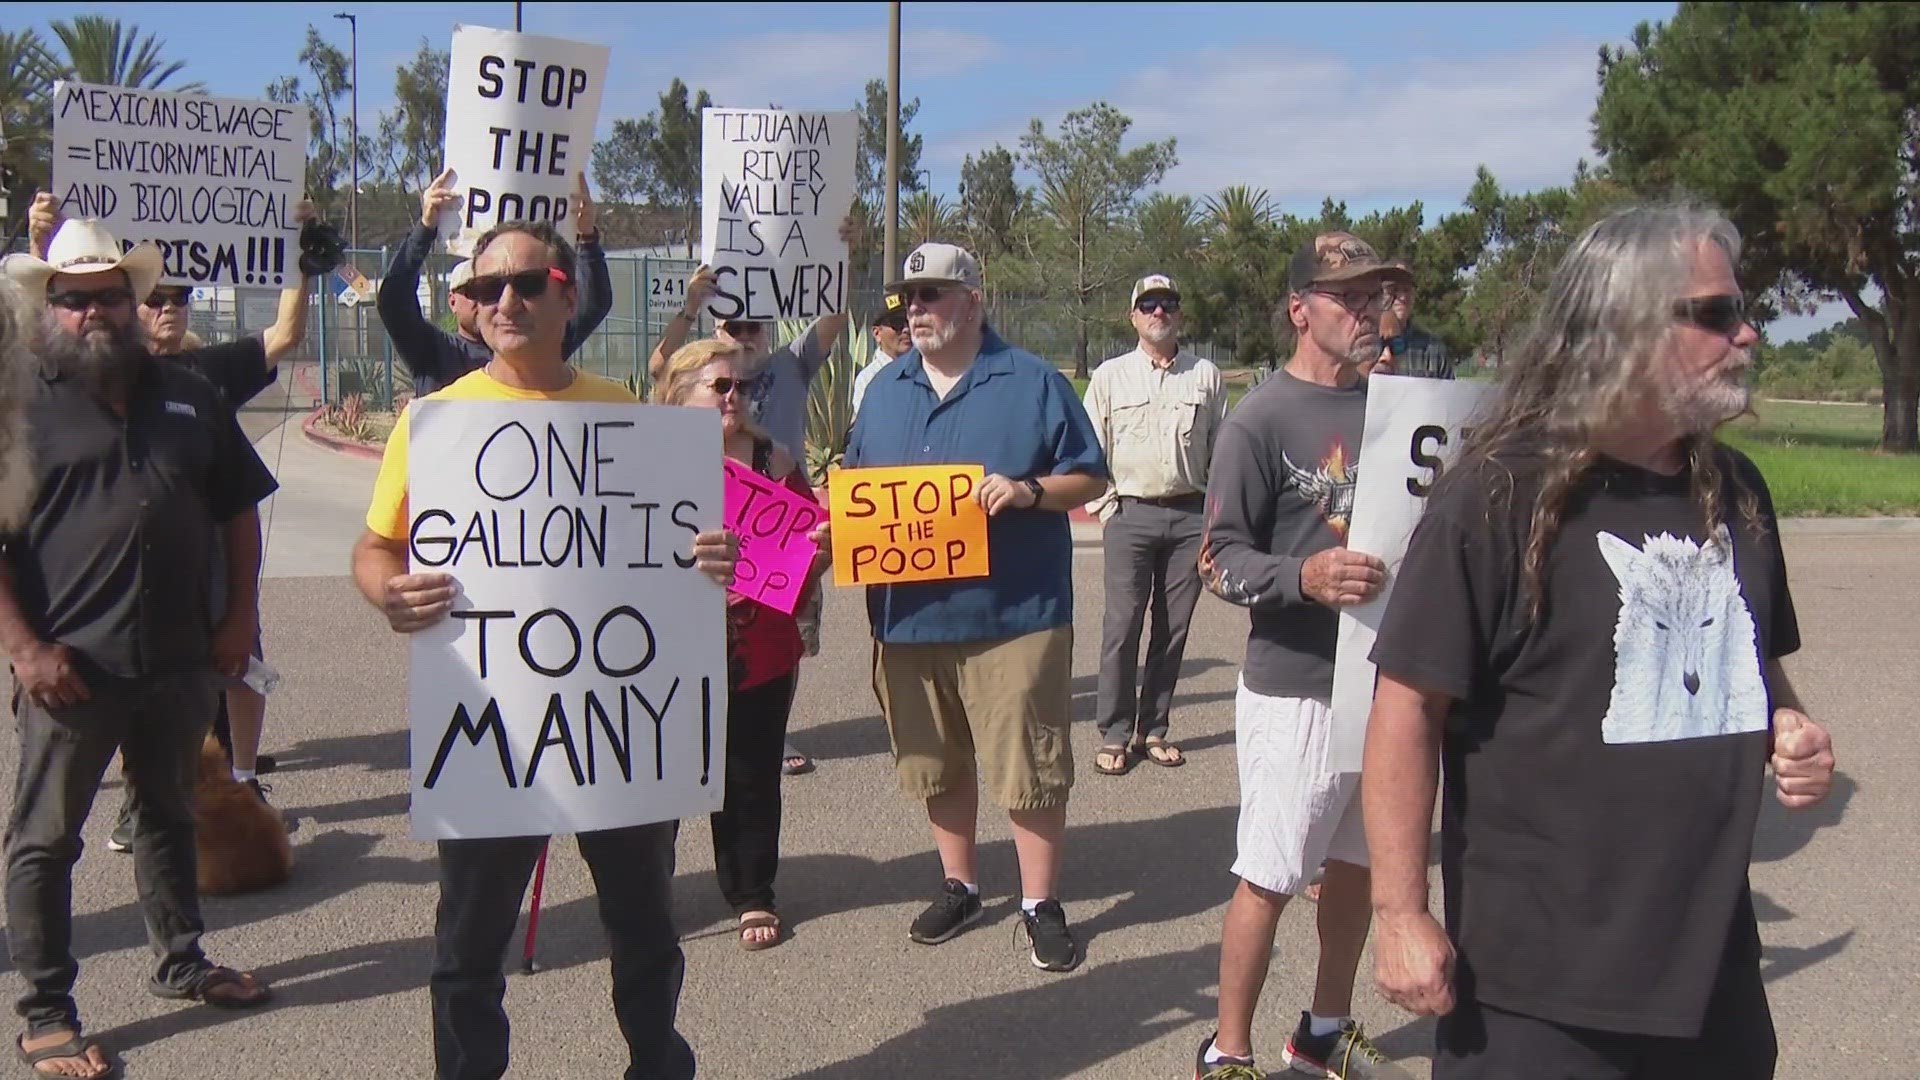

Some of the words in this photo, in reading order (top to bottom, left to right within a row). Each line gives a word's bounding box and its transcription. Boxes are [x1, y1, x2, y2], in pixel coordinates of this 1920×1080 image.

[478, 55, 587, 110] STOP
[60, 87, 178, 130] MEXICAN
[185, 100, 294, 142] SEWAGE
[713, 113, 831, 146] TIJUANA
[489, 126, 569, 177] THE
[743, 149, 824, 182] RIVER
[59, 182, 118, 218] AND
[130, 182, 299, 231] BIOLOGICAL
[466, 187, 568, 229] POOP
[721, 183, 826, 216] VALLEY
[715, 217, 765, 257] IS
[779, 219, 809, 258] A
[475, 420, 635, 502] ONE
[723, 465, 817, 553] TOP
[846, 473, 973, 520] STOP
[410, 505, 607, 569] GALLON
[628, 500, 700, 569] IS
[880, 519, 934, 543] THE
[733, 557, 790, 601] OP
[852, 539, 966, 584] POOP
[450, 605, 656, 679] TOO
